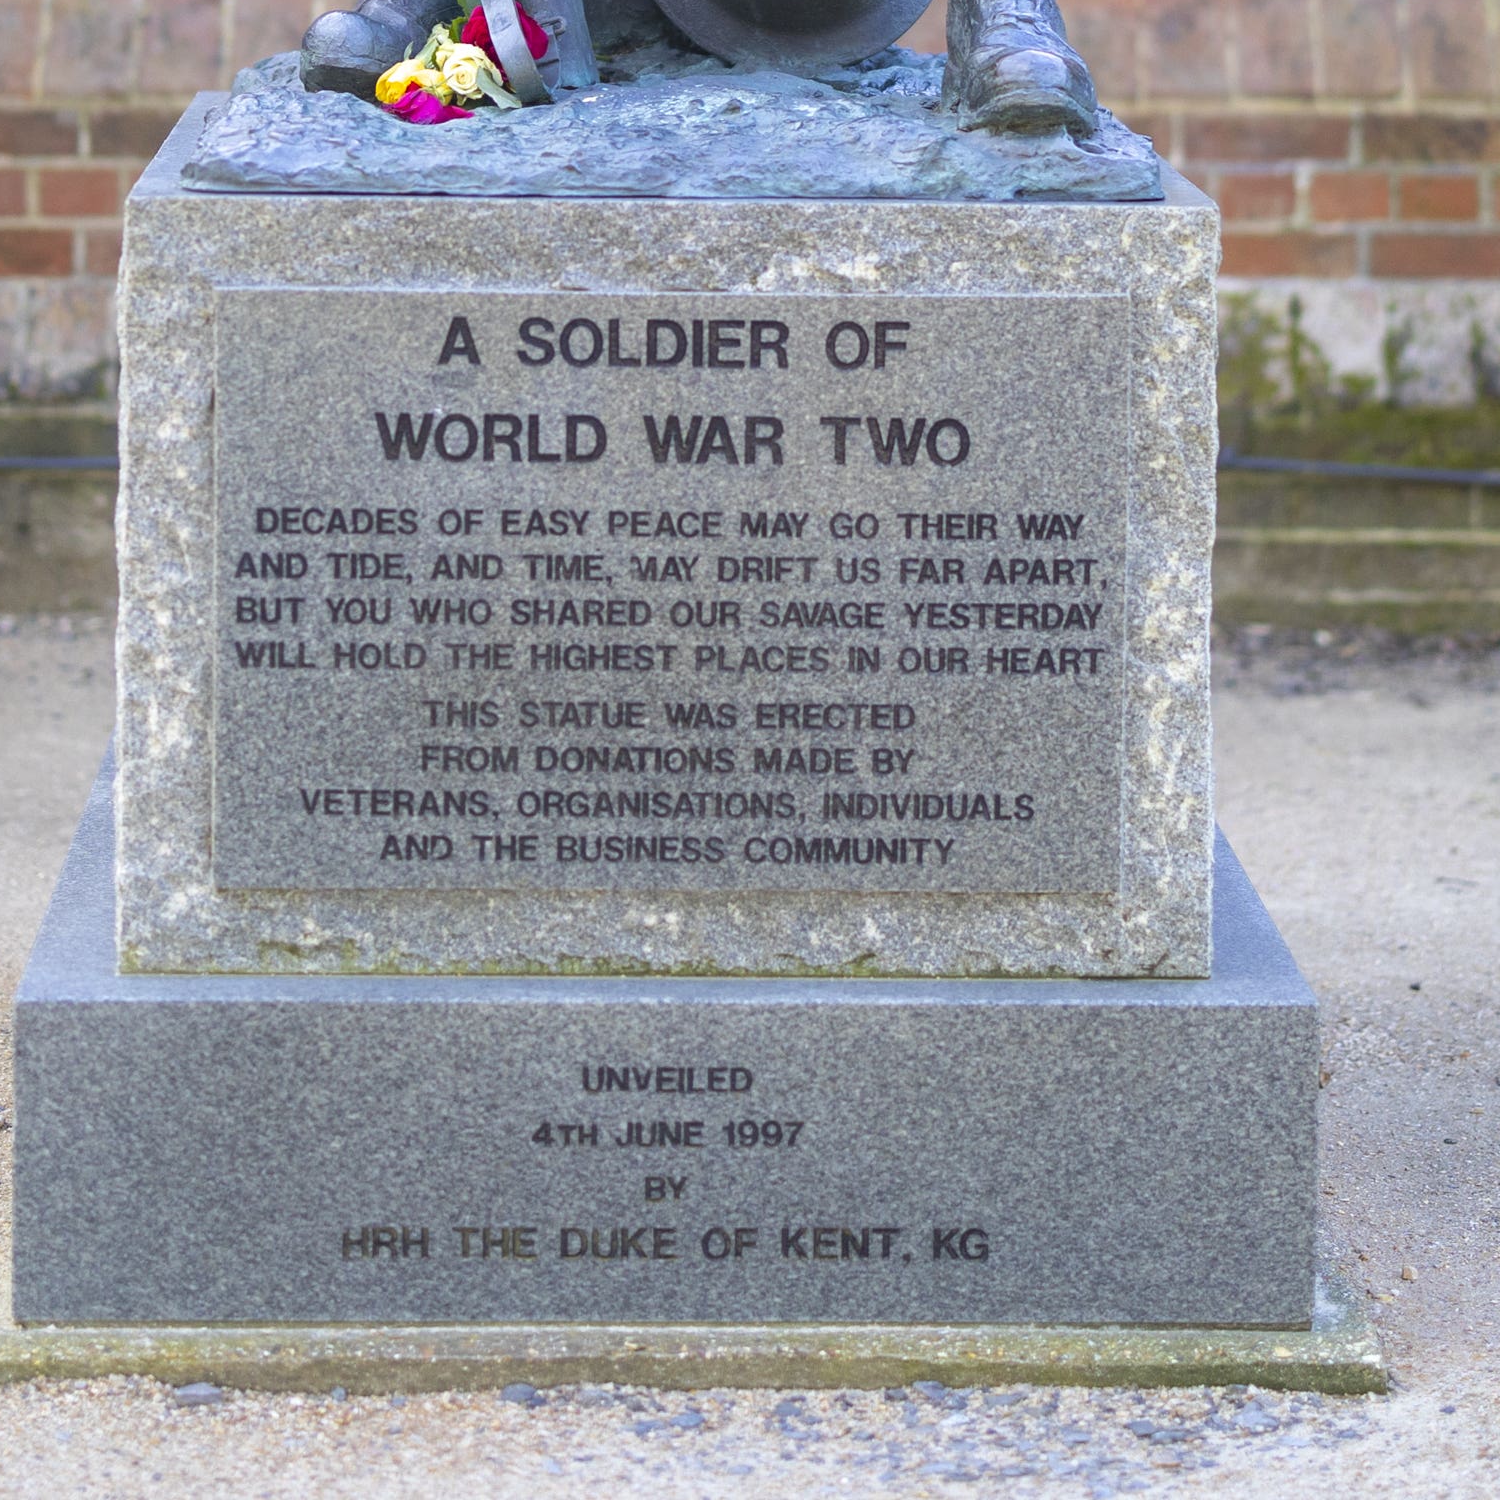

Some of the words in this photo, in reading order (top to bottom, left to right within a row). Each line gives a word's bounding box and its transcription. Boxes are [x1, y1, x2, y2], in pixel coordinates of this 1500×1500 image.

[437, 315, 481, 366] A
[516, 316, 790, 369] SOLDIER
[825, 320, 911, 371] OF
[373, 411, 608, 464] WORLD
[643, 414, 784, 466] WAR
[819, 415, 972, 467] TWO
[255, 506, 418, 535] DECADES
[437, 508, 483, 535] OF
[501, 509, 590, 536] EASY
[607, 510, 722, 538] PEACE
[740, 512, 809, 538] MAY
[829, 512, 880, 540] GO
[898, 512, 998, 541] THEIR
[1016, 513, 1084, 541] WAY
[236, 552, 308, 580] AND
[327, 552, 415, 587] TIDE,
[431, 554, 503, 580] AND
[523, 554, 615, 589] TIME,
[632, 556, 698, 581] MAY
[717, 556, 817, 583] DRIFT
[836, 557, 881, 584] US
[900, 558, 965, 584] FAR
[984, 558, 1109, 593] APART,
[236, 597, 304, 625] BUT
[326, 598, 391, 625] YOU
[410, 599, 492, 626] WHO
[511, 599, 652, 626] SHARED
[670, 601, 740, 628] OUR
[759, 602, 884, 629] SAVAGE
[905, 602, 1102, 630] YESTERDAY
[234, 642, 315, 669] WILL
[333, 642, 426, 670] HOLD
[451, 644, 512, 669] THE
[531, 644, 676, 671] HIGHEST
[695, 646, 830, 672] PLACES
[849, 647, 880, 673] IN
[898, 647, 969, 674] OUR
[987, 647, 1103, 676] HEART
[423, 700, 498, 727] THIS
[520, 701, 642, 728] STATUE
[665, 703, 736, 729] WAS
[756, 703, 916, 731] ERECTED
[421, 744, 518, 772] FROM
[535, 746, 733, 773] DONATIONS
[755, 748, 853, 775] MADE
[872, 748, 915, 775] BY
[300, 788, 501, 824] VETERANS,
[517, 790, 806, 826] ORGANISATIONS,
[824, 793, 1035, 823] INDIVIDUALS
[380, 834, 453, 860] AND
[473, 835, 537, 861] THE
[557, 836, 724, 862] BUSINESS
[744, 837, 954, 864] COMMUNITY
[580, 1064, 755, 1095] UNVEILED
[531, 1120, 599, 1147] 4TH
[615, 1120, 704, 1148] JUNE
[723, 1119, 805, 1148] 1997
[644, 1176, 687, 1202] BY
[341, 1226, 431, 1260] HRH
[454, 1226, 537, 1259] THE
[559, 1227, 676, 1260] DUKE
[700, 1226, 758, 1261] OF
[780, 1226, 913, 1269] KENT,
[931, 1226, 991, 1263] KG
